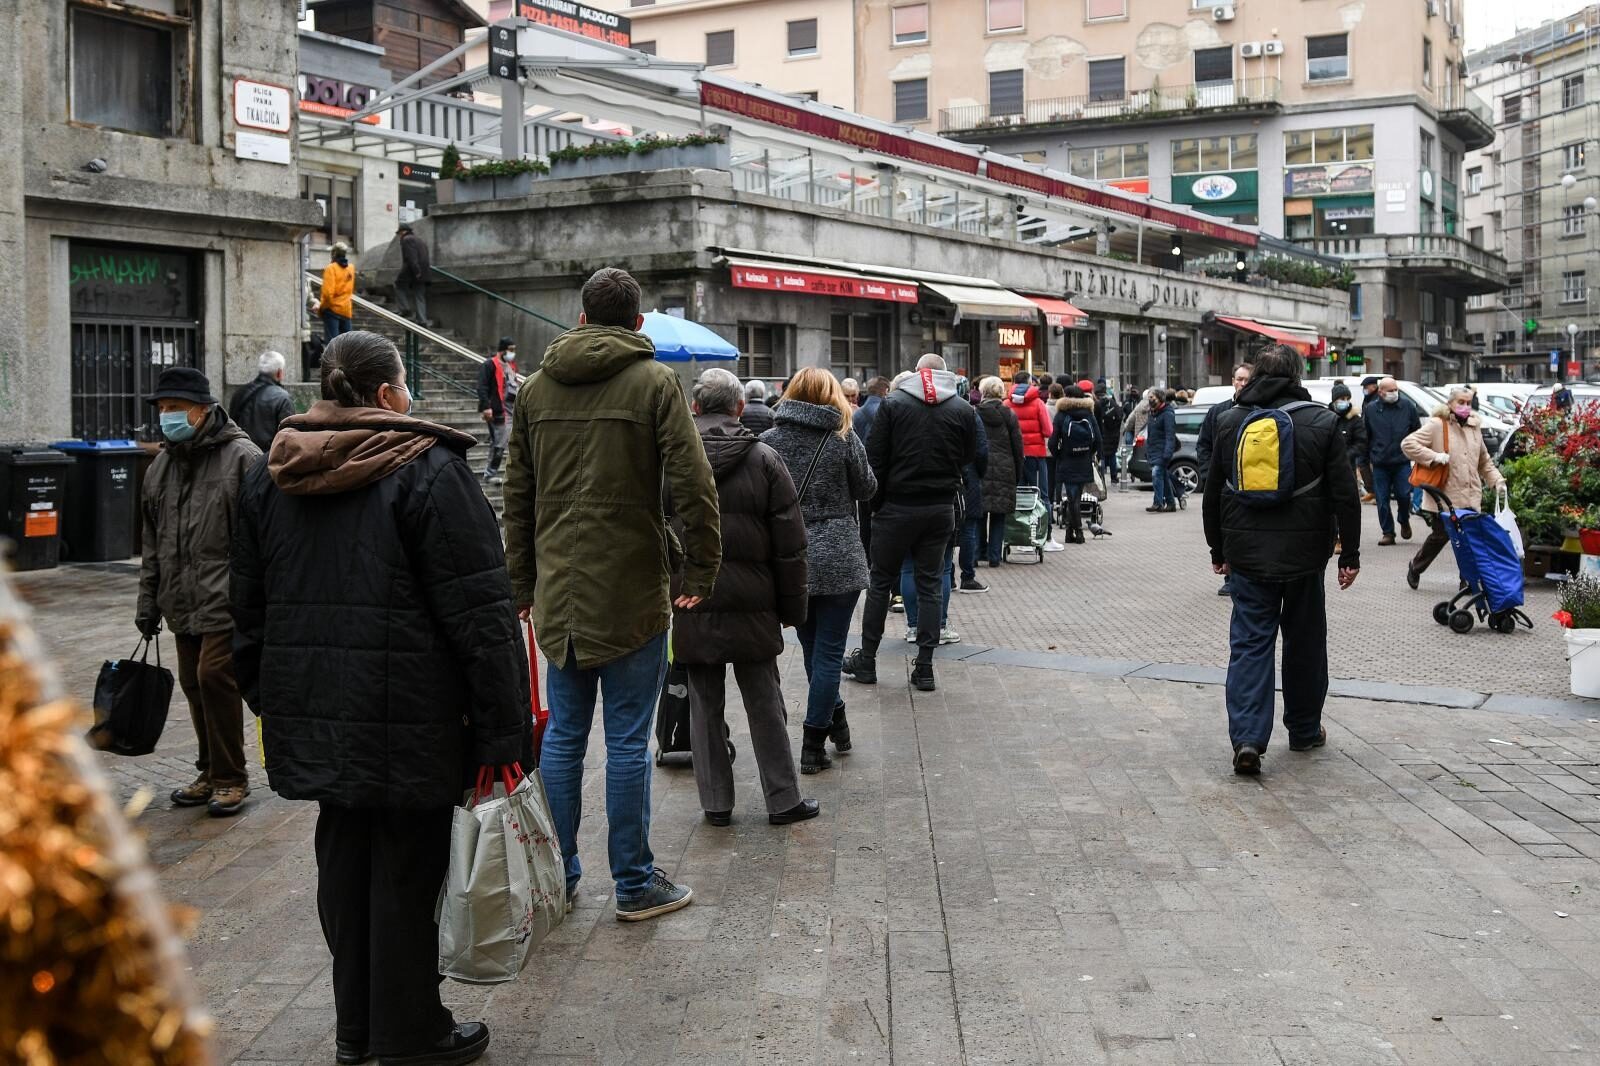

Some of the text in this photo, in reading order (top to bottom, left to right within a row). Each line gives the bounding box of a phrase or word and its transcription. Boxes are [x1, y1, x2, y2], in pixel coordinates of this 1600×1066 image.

[253, 97, 272, 106] IVANA
[1152, 283, 1200, 307] DOLAC
[998, 328, 1026, 346] TISAK
